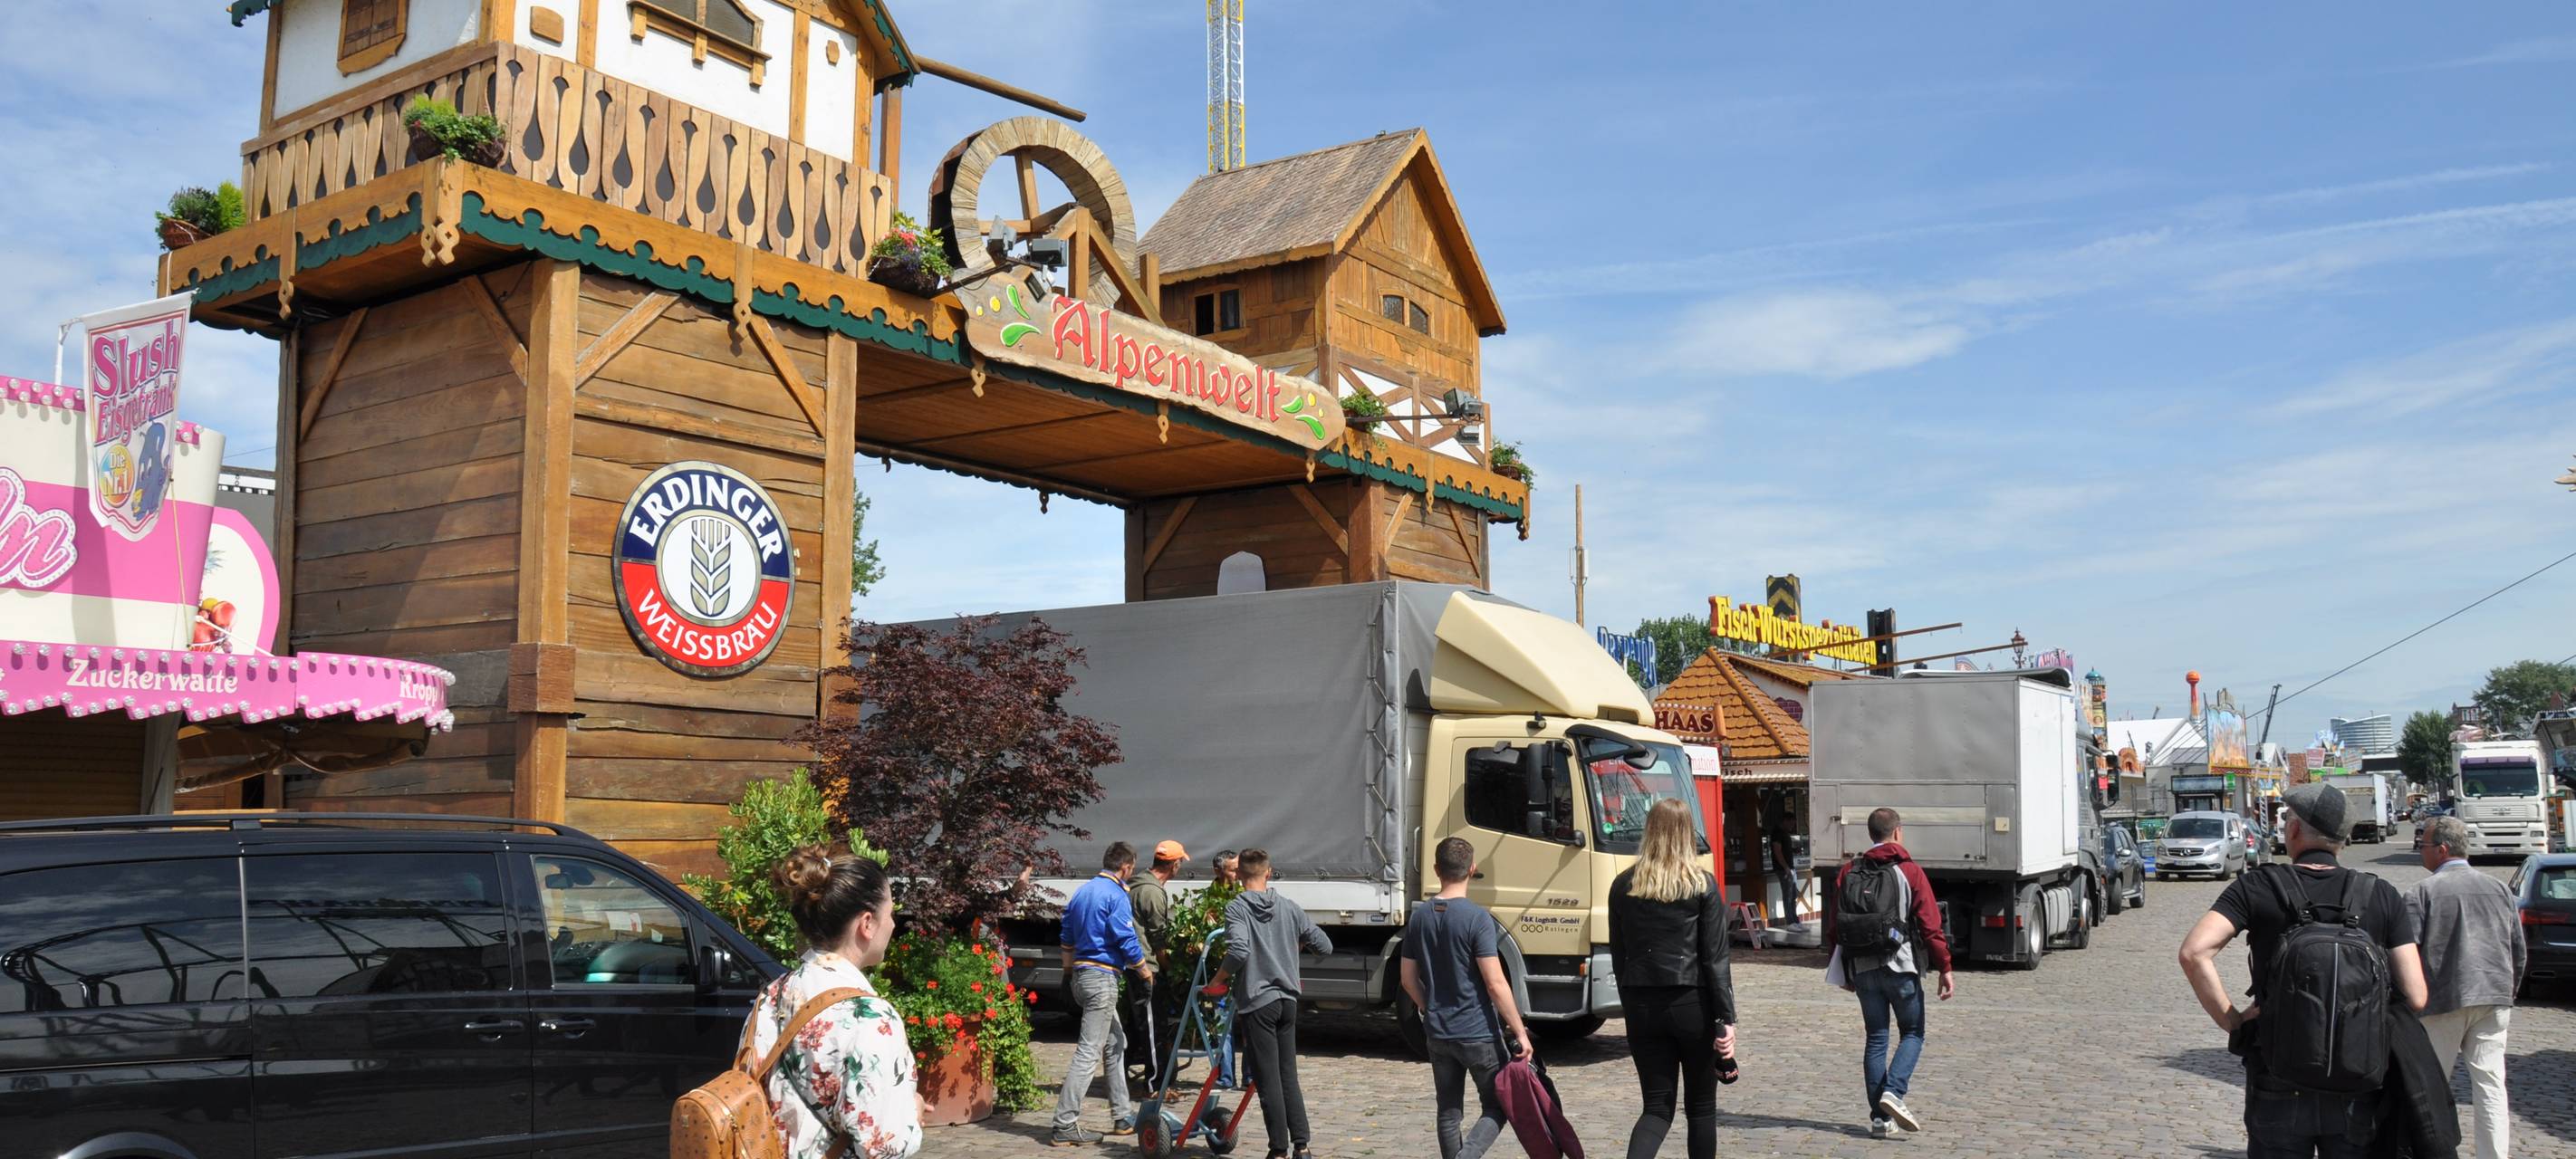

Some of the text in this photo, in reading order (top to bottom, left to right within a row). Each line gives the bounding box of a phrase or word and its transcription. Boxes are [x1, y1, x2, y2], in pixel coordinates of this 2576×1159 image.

[92, 320, 181, 400] Slush
[1051, 293, 1282, 423] Alpenwelt
[94, 376, 178, 446] Eisgetränk
[103, 468, 130, 496] Nr.1
[109, 450, 126, 470] Die
[629, 474, 783, 563] ERDINGER
[639, 588, 778, 661] WEISSBRÄU
[66, 657, 238, 694] Zuckerwatte
